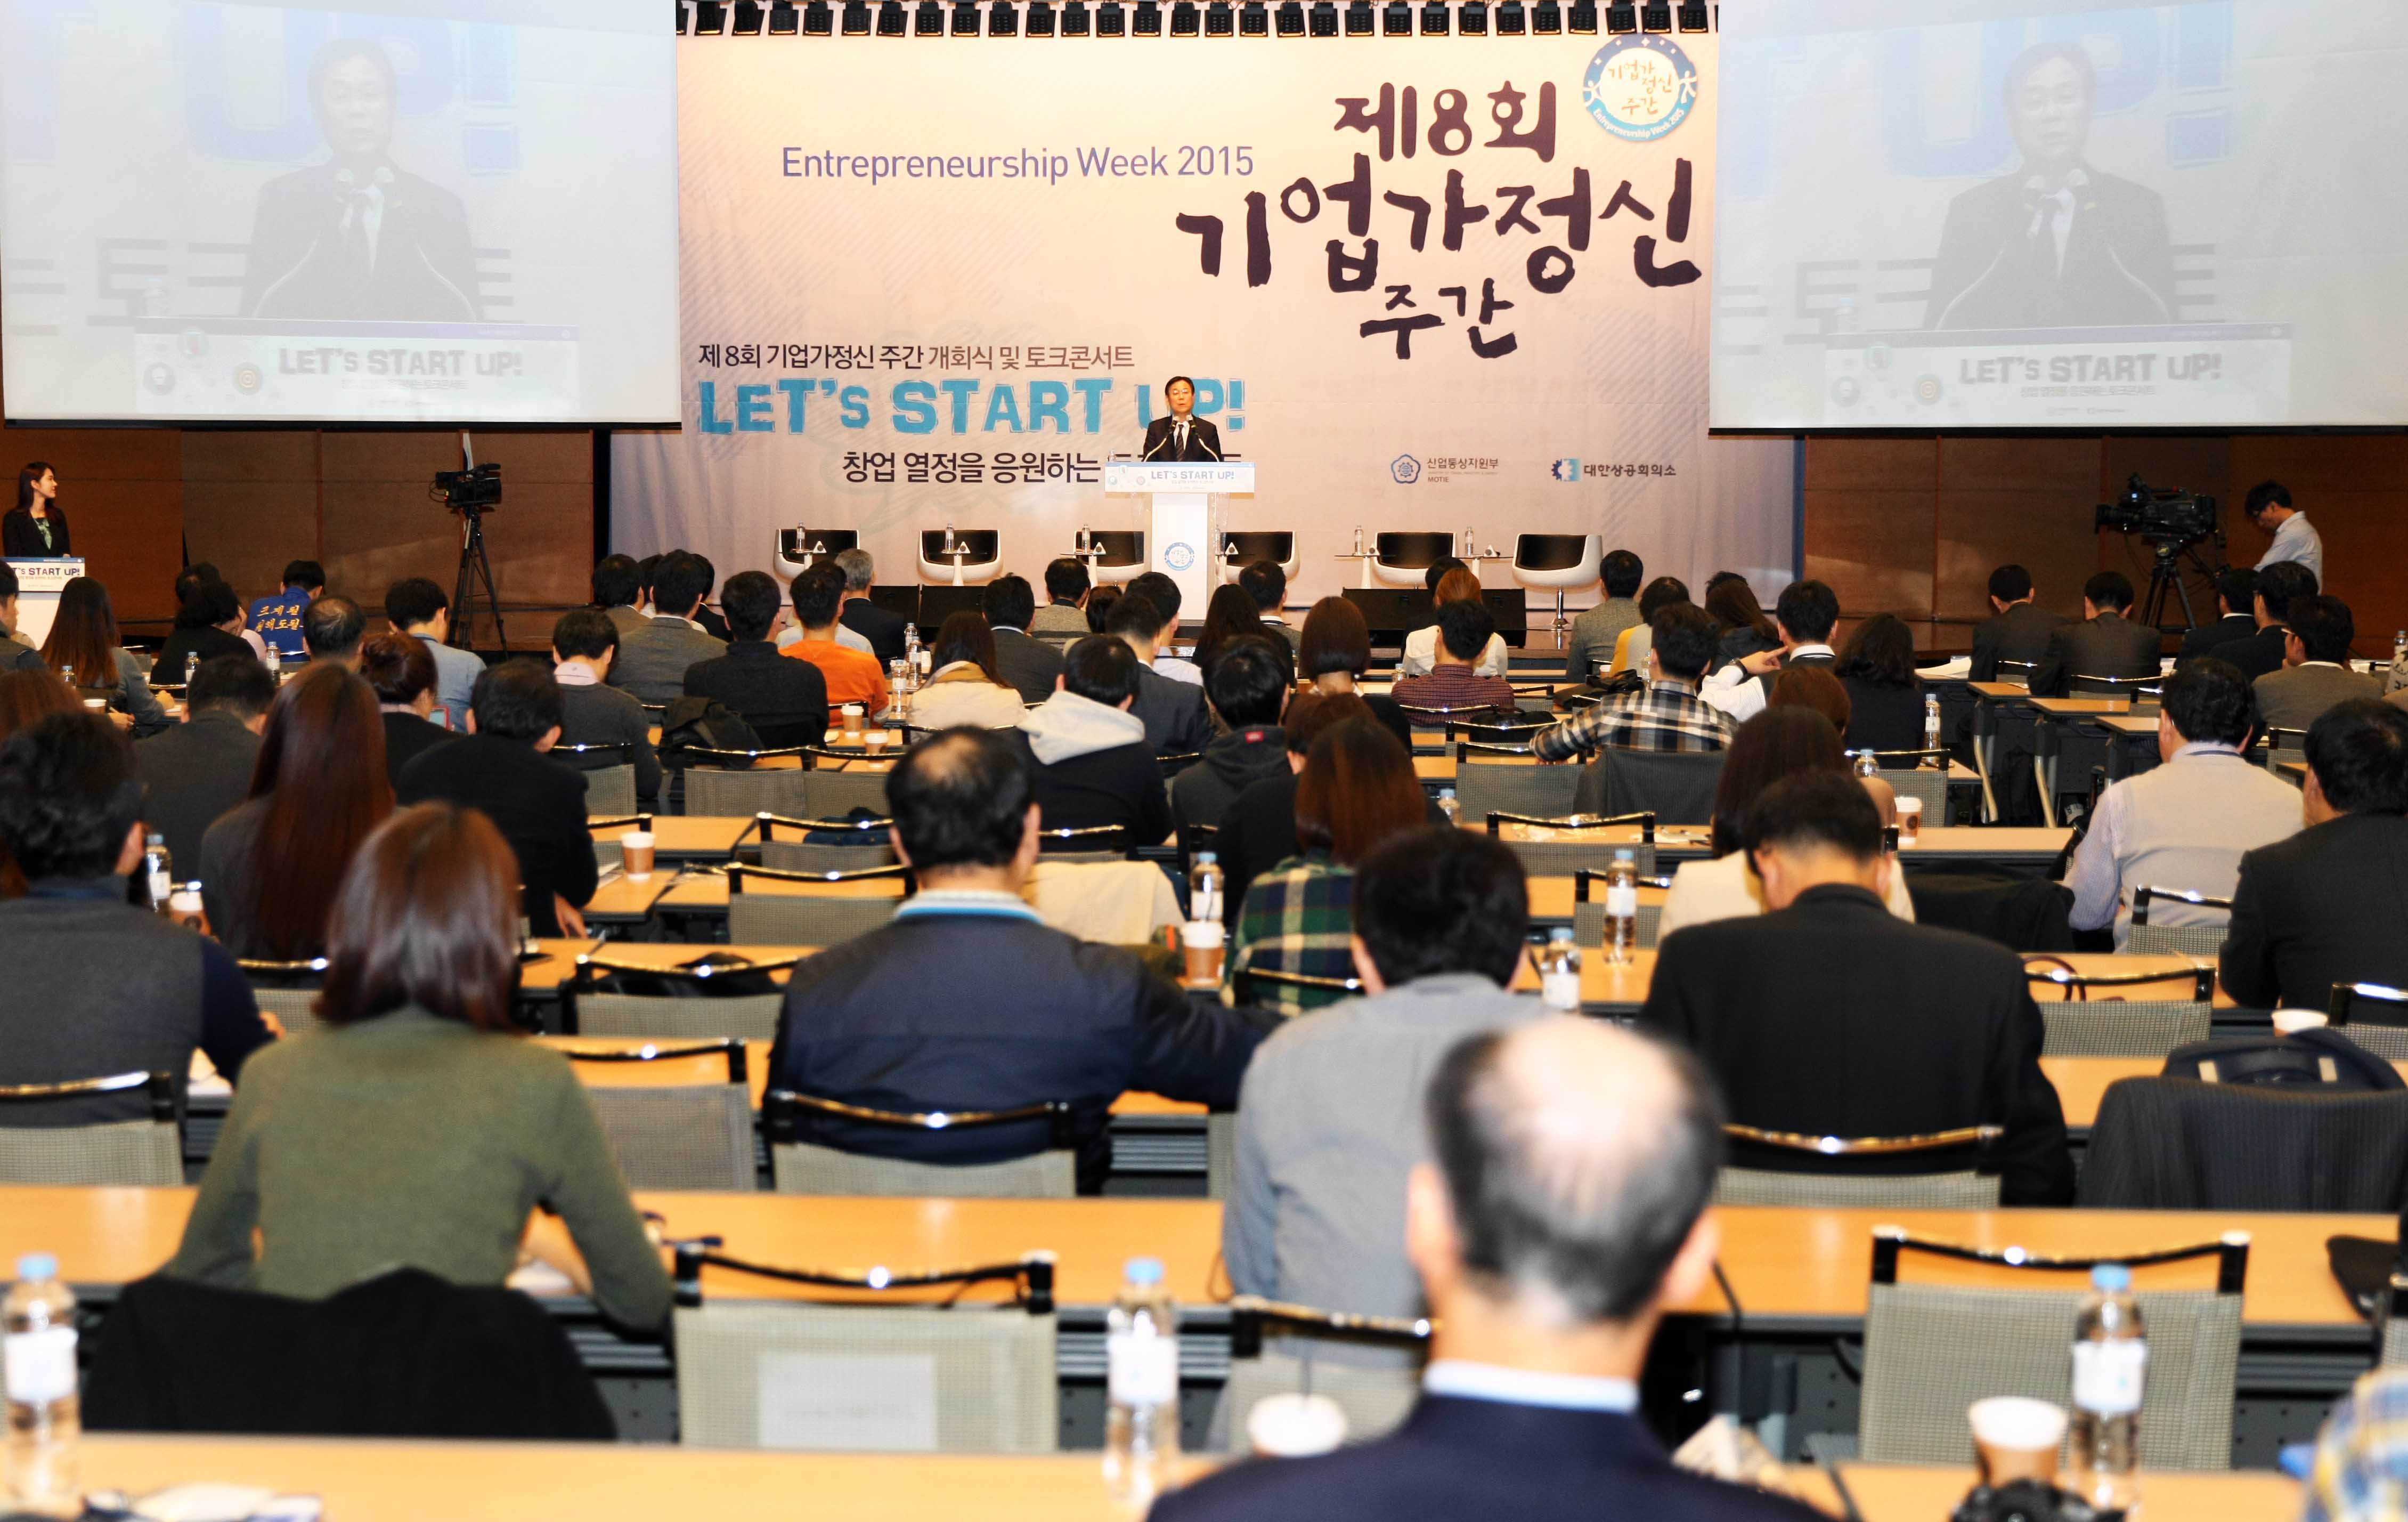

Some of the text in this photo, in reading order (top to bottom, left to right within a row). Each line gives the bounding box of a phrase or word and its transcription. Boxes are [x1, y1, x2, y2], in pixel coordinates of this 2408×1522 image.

[1608, 59, 1655, 80] 기업가
[1641, 74, 1672, 93] 정신
[1622, 97, 1658, 115] 주간
[1333, 80, 1556, 162] 제8회
[1592, 108, 1685, 138] Entrepreneurship Week 2015
[783, 145, 1254, 186] Entrepreneurship Week 2015
[1176, 152, 1702, 293] 기업가정신
[1360, 278, 1518, 360] 주간
[367, 349, 466, 377] START
[475, 351, 524, 378] UP!
[767, 344, 874, 370] 기업가정신
[880, 345, 924, 370] 주간
[928, 345, 993, 370] 개회식
[999, 345, 1020, 370] 및
[1024, 345, 1135, 370] 토크콘서트
[2048, 353, 2157, 383] START
[2166, 352, 2223, 380] UP!
[889, 377, 1113, 434] START
[842, 451, 1101, 484] 창업 열정을 응원하는
[1181, 471, 1214, 480] START
[1218, 471, 1235, 480] UP!
[1427, 458, 1498, 469] 산업통상자원부
[1584, 464, 1677, 477] 대한상공회의소
